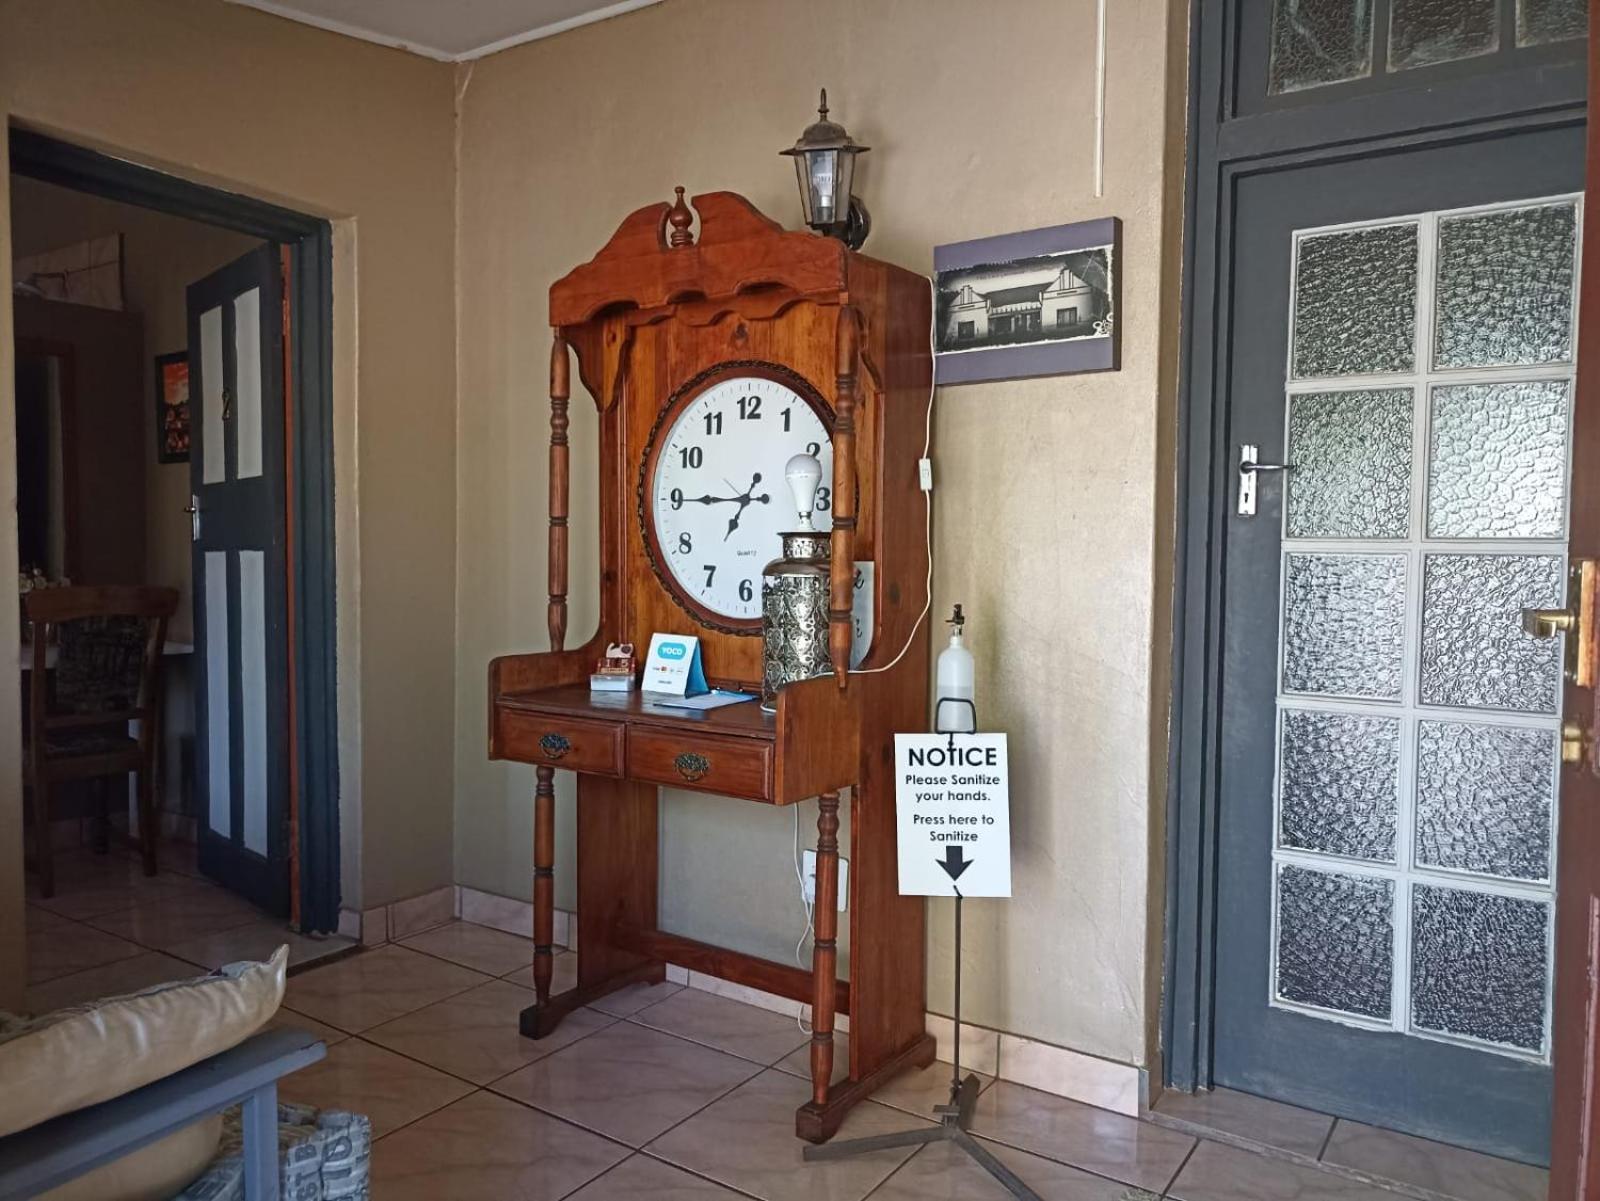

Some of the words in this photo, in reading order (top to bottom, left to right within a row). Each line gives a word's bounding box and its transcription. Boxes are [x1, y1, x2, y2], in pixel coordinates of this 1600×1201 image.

[737, 396, 762, 420] 12
[703, 412, 723, 435] 11
[780, 408, 791, 432] 1
[679, 446, 703, 469] 10
[670, 488, 683, 510] 9
[815, 487, 831, 511] 3
[679, 532, 692, 554] 8
[703, 565, 717, 588] 7
[738, 579, 753, 602] 6
[908, 747, 997, 766] NOTICE
[905, 774, 948, 785] Please
[951, 774, 1001, 785] Sanitize
[915, 791, 943, 803] your
[948, 790, 991, 802] hands.
[913, 814, 945, 825] Press
[949, 814, 978, 825] here
[982, 814, 995, 825] to
[929, 830, 979, 842] Sanitize
